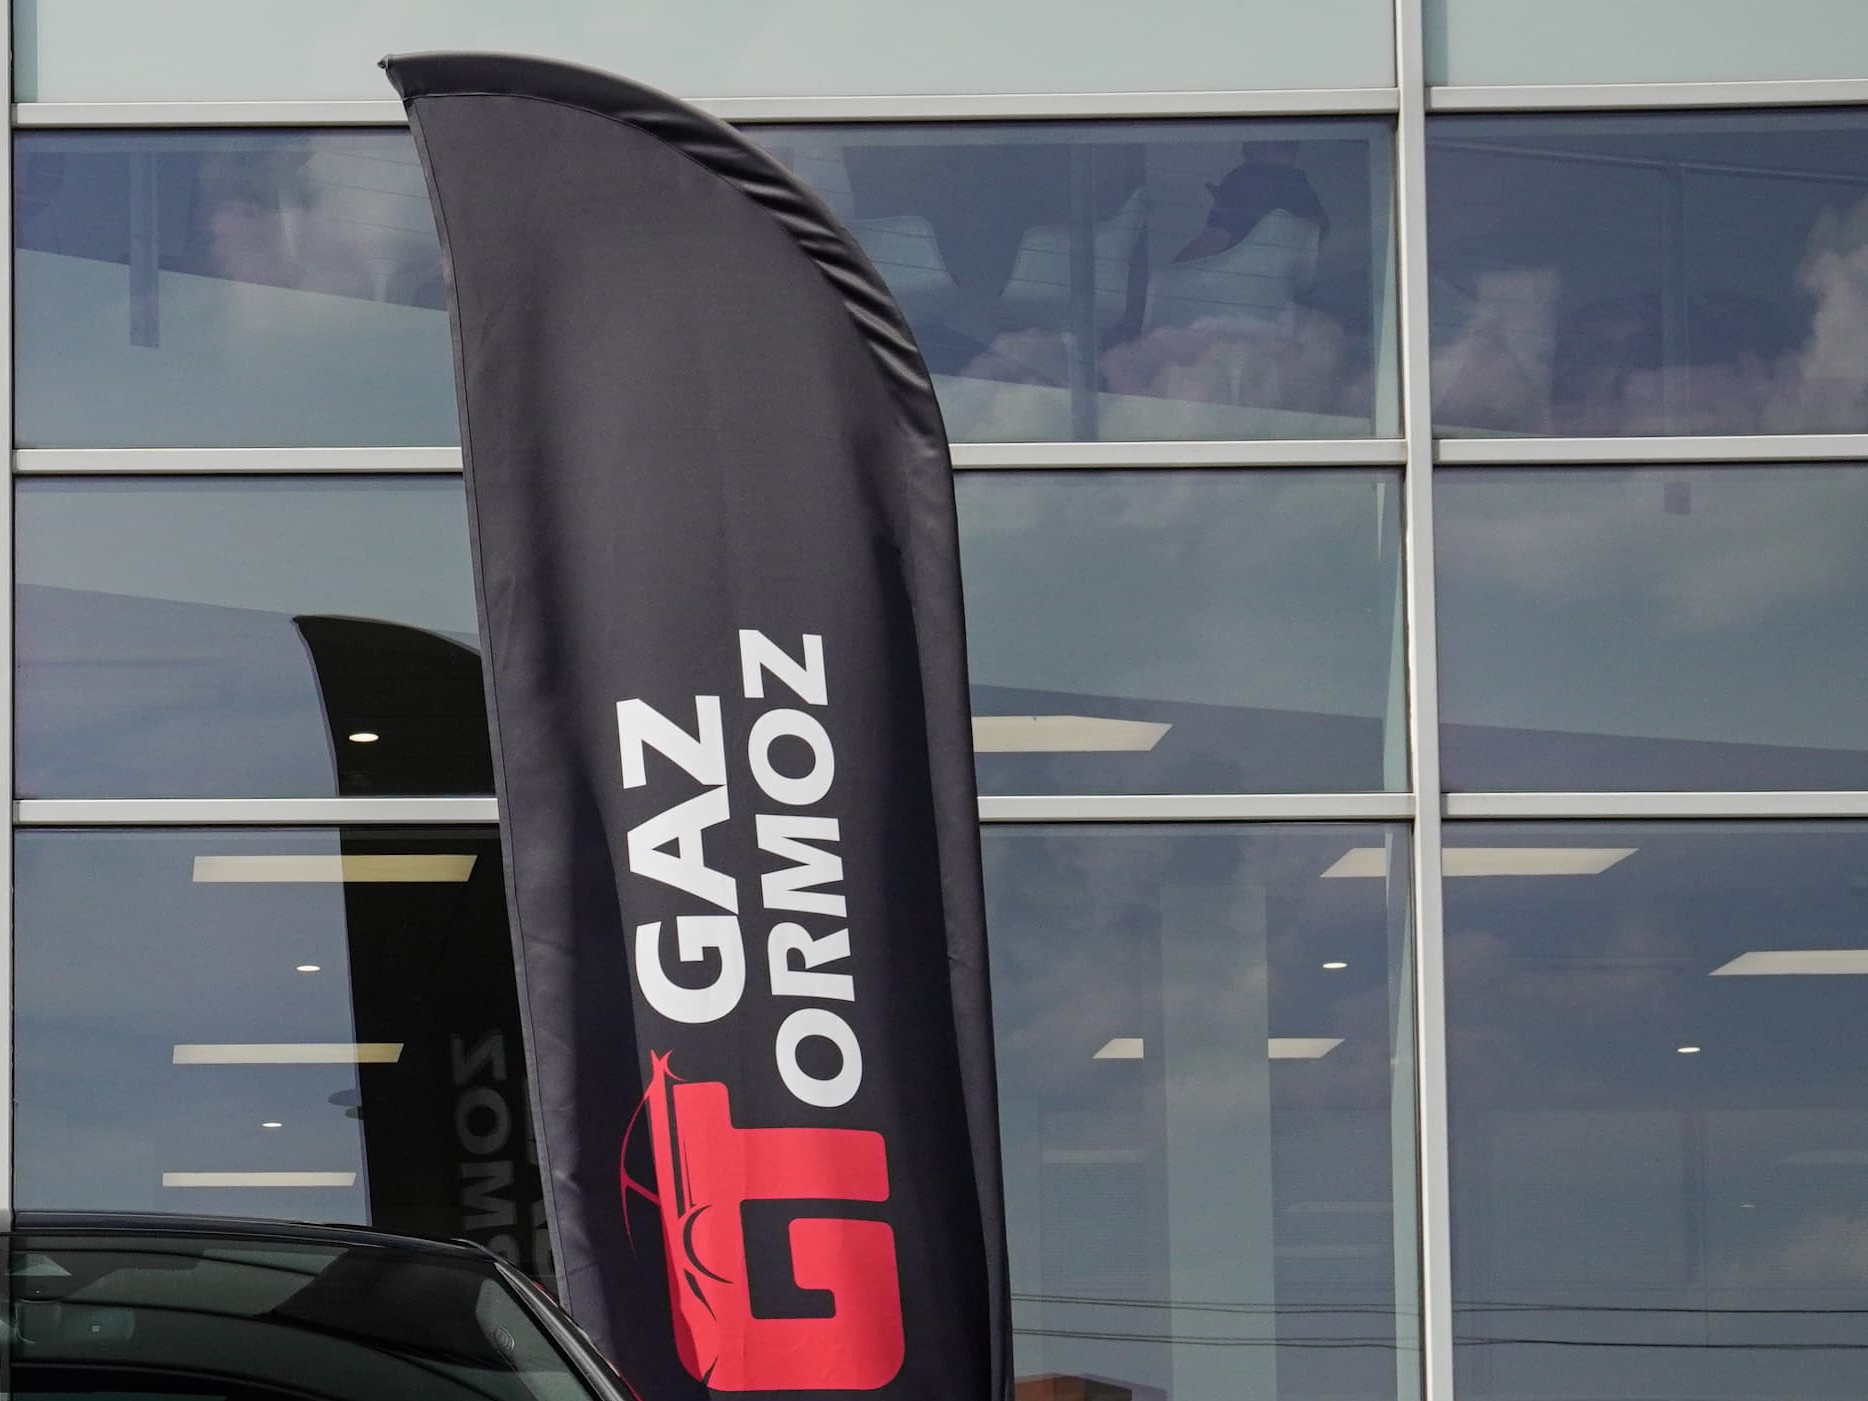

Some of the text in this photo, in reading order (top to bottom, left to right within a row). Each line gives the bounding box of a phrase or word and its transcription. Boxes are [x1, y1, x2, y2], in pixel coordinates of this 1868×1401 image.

[616, 694, 746, 1025] GAZ
[739, 629, 863, 1108] ORMOZ
[657, 1080, 907, 1392] GT
